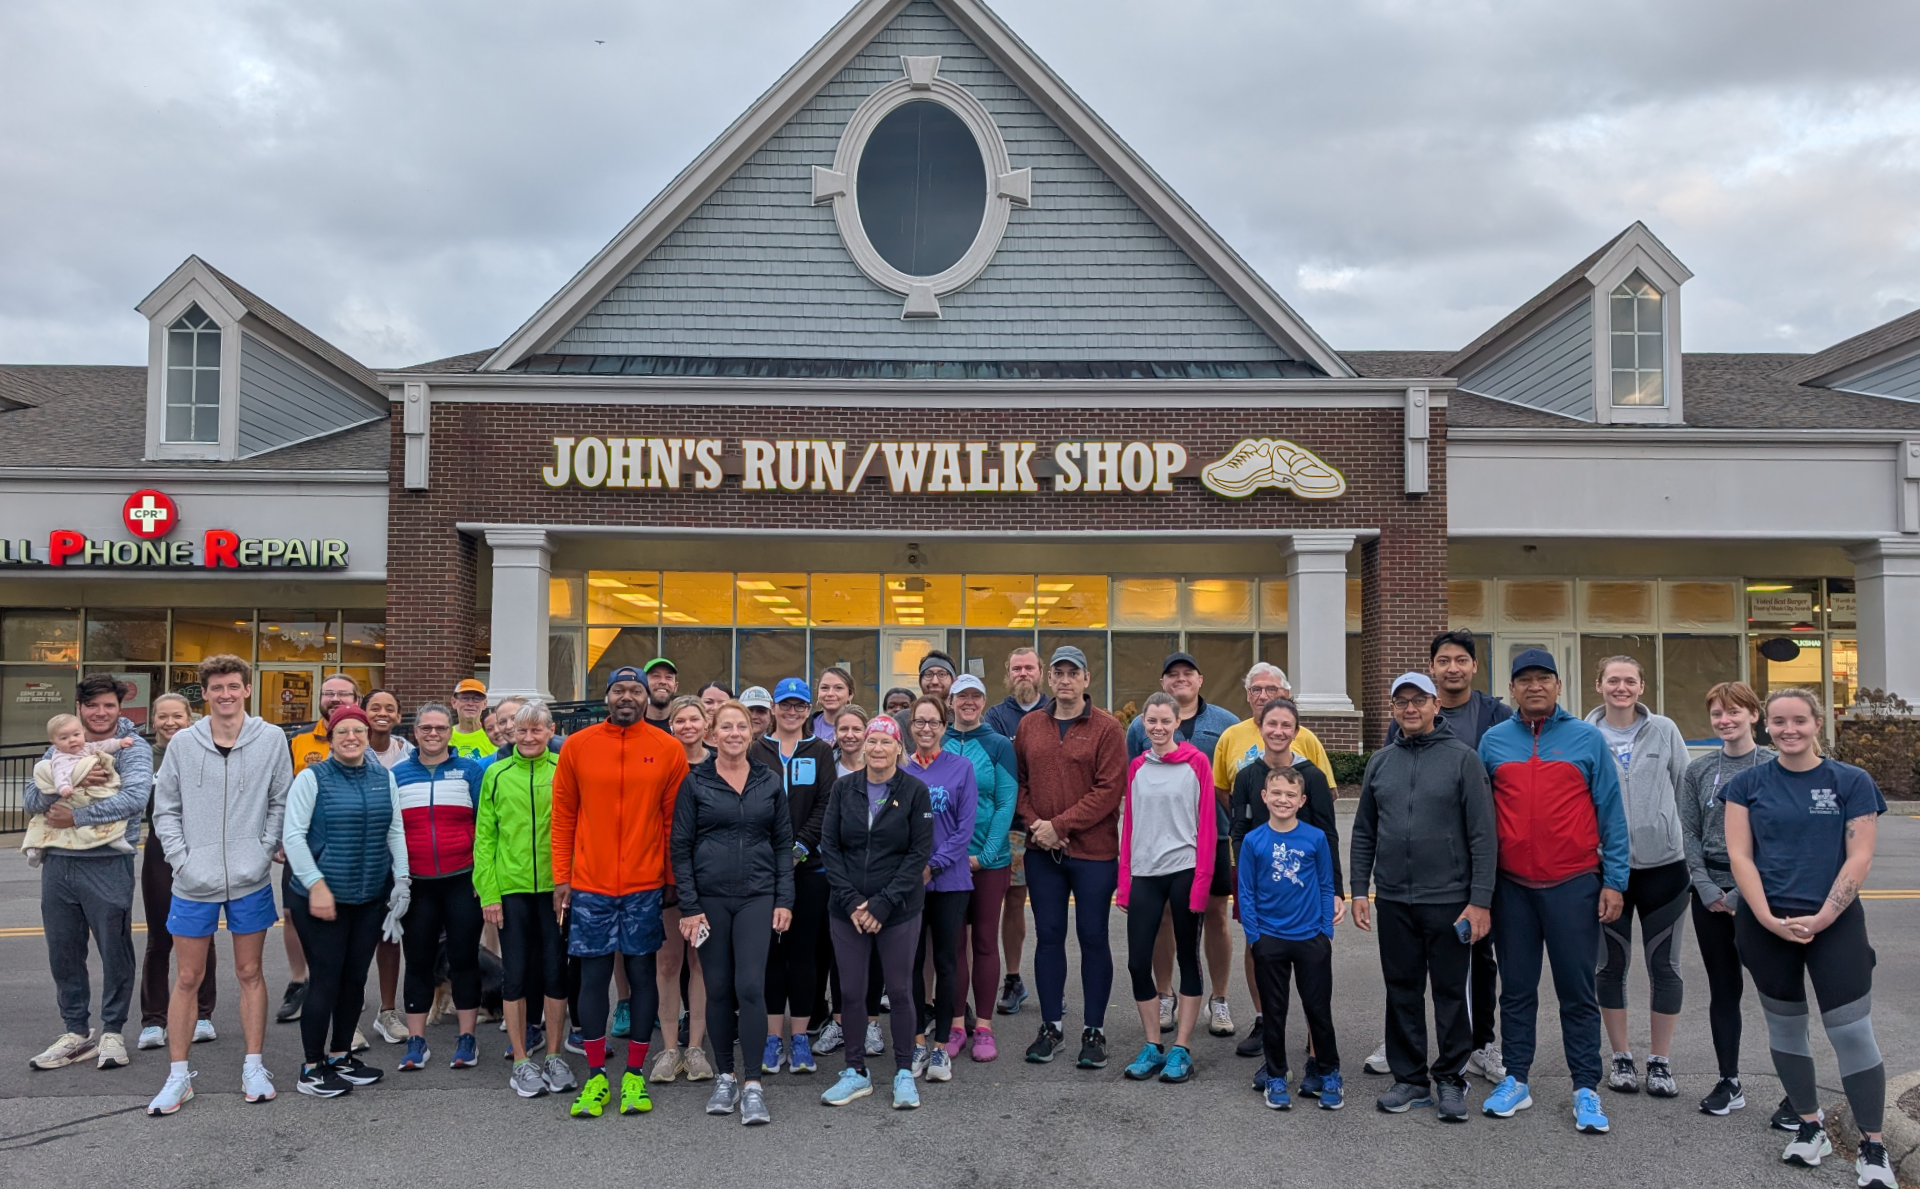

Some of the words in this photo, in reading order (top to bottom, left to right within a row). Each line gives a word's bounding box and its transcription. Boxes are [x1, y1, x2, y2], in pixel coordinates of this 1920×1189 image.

[542, 436, 723, 489] JOHN'S
[742, 439, 1039, 493] RUN/WALK
[1054, 441, 1188, 493] SHOP
[0, 538, 40, 564] LL
[49, 529, 192, 567] PHONE
[204, 529, 348, 568] REPAIR
[1787, 598, 1807, 606] Burger
[178, 688, 201, 699] OPE
